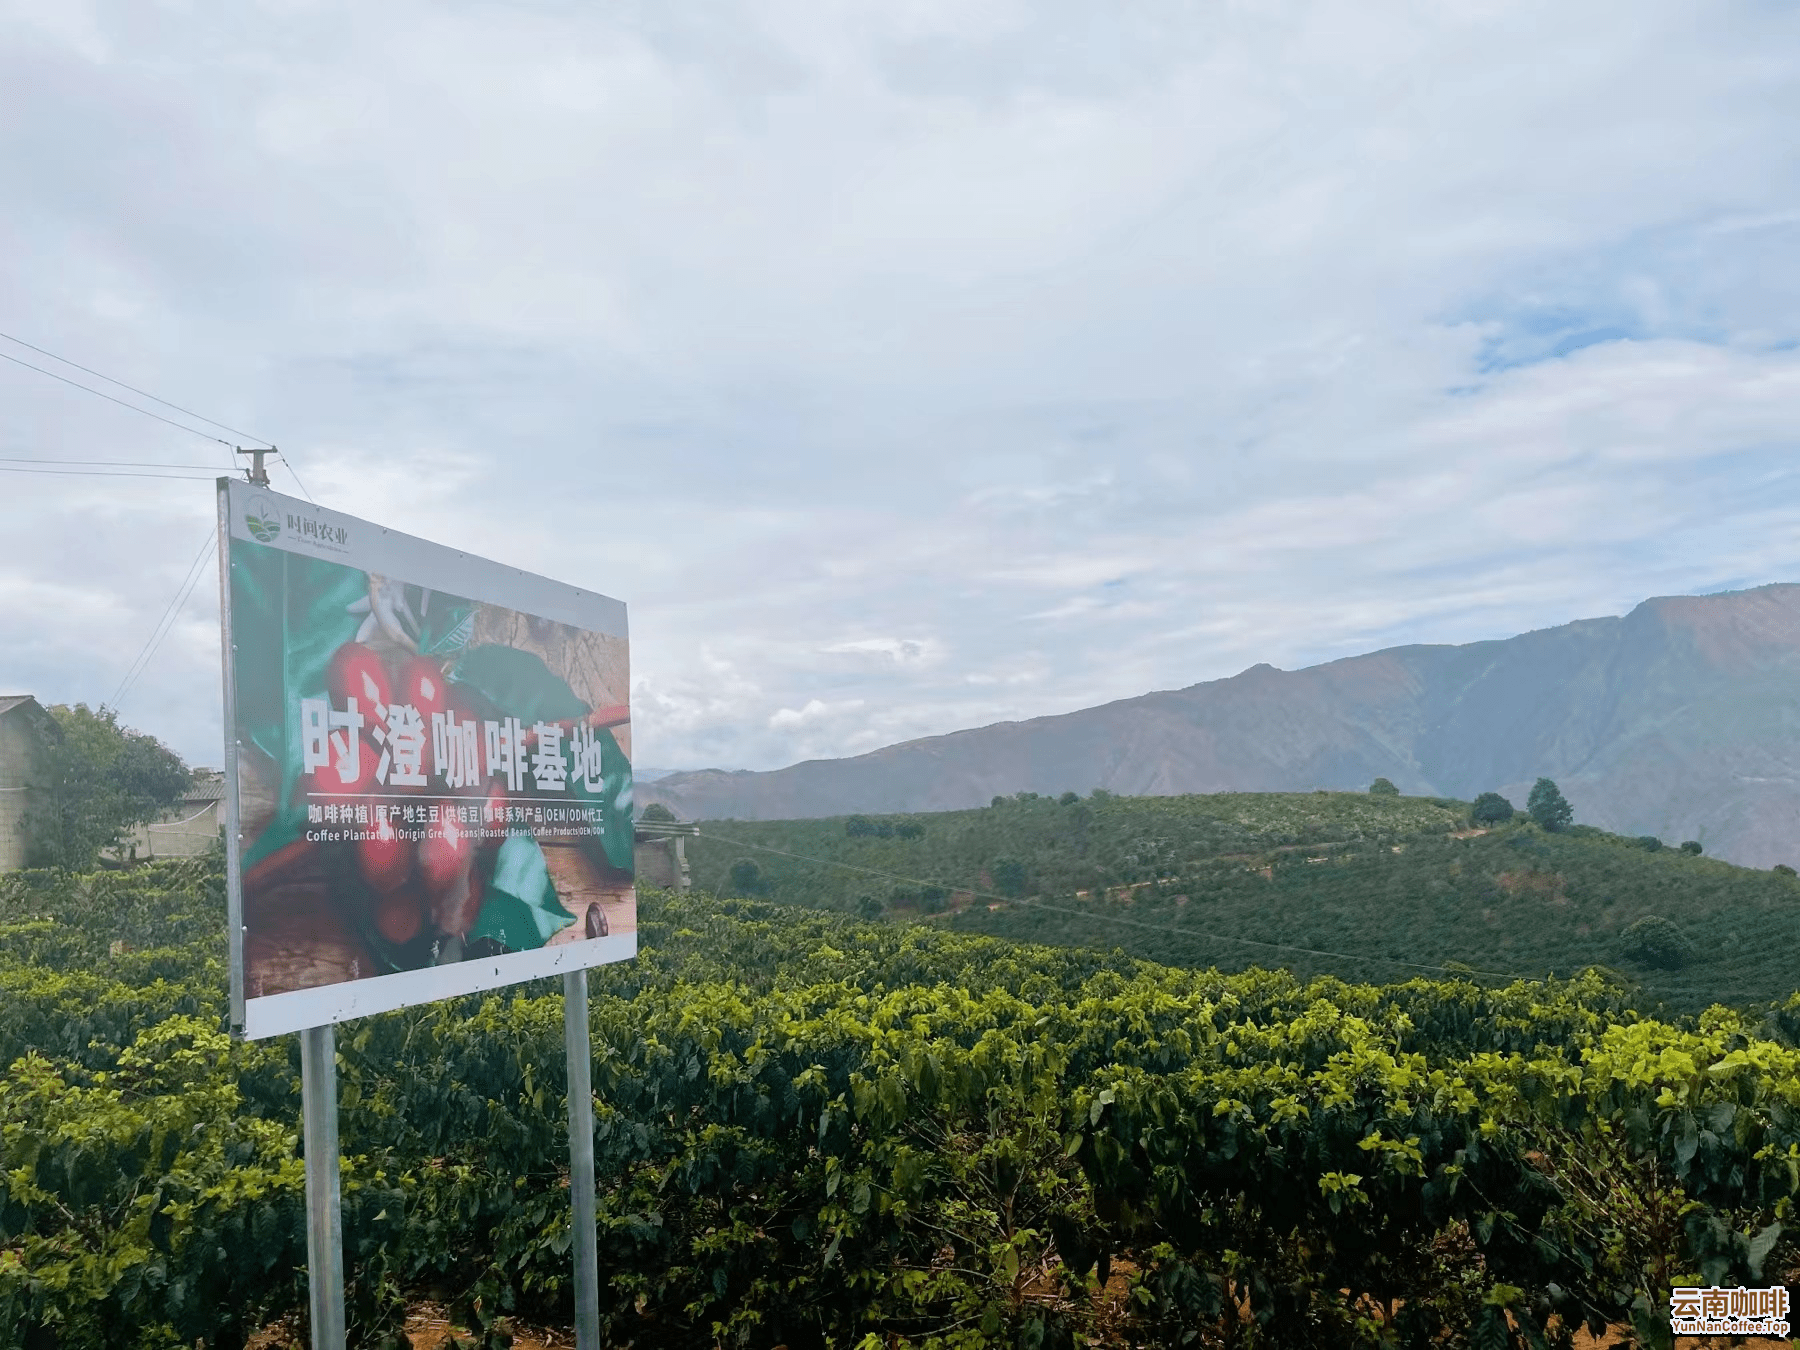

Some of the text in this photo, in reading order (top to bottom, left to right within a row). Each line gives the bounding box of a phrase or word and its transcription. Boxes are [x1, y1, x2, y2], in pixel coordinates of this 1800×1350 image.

[286, 513, 348, 545] 时间农业
[301, 696, 605, 793] 时澄咖啡基地
[306, 829, 341, 842] Coffee
[342, 828, 426, 842] Plantatn|Origin
[428, 828, 453, 840] Gree
